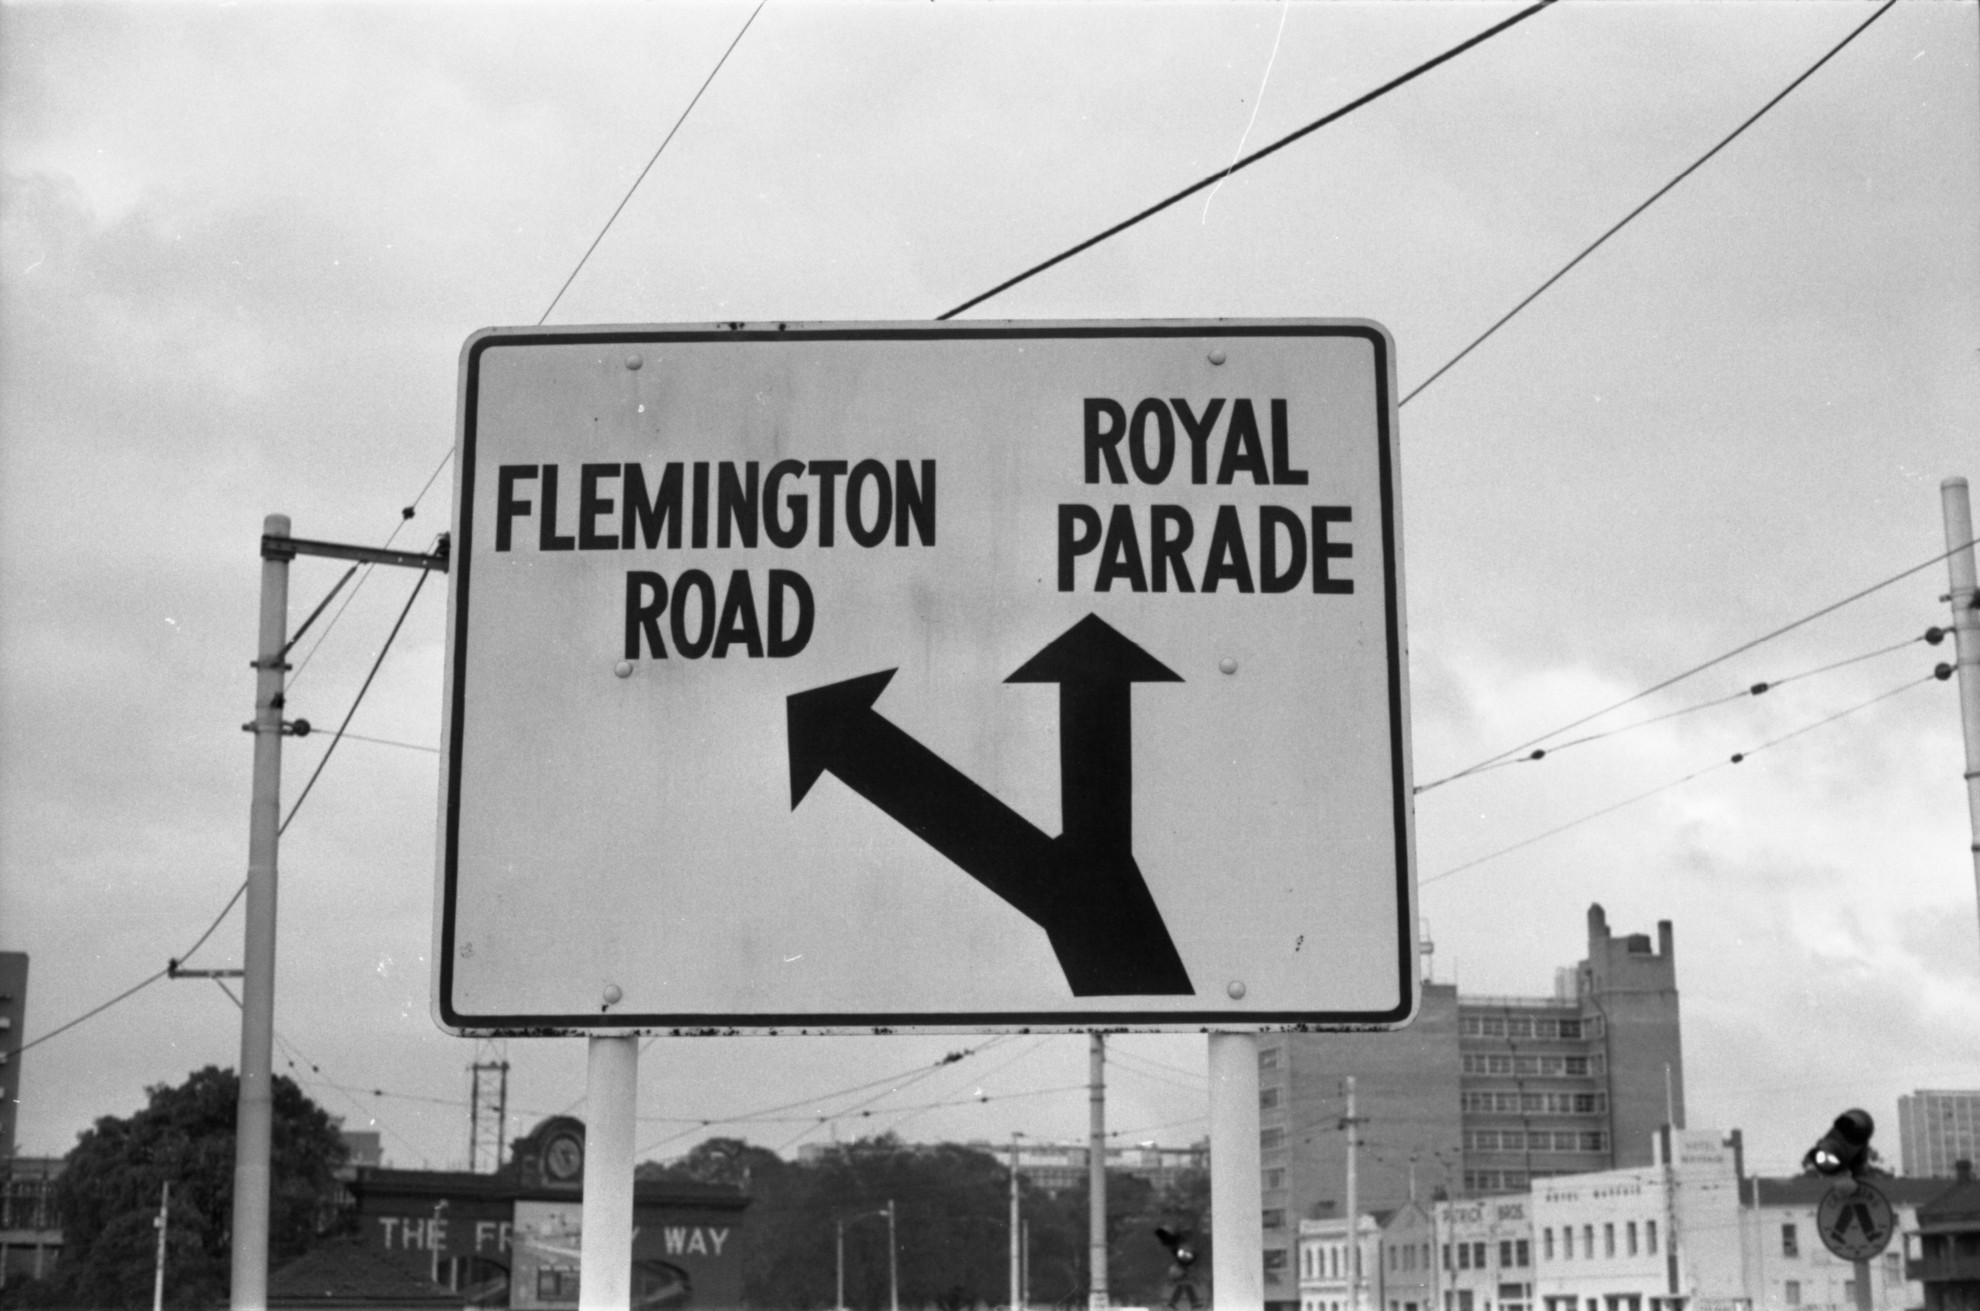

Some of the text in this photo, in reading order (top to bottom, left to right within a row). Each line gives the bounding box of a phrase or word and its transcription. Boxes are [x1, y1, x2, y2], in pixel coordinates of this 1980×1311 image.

[1083, 397, 1309, 486] ROYAL
[495, 458, 936, 553] FLEMINGTON
[1057, 503, 1355, 595] PARADE
[624, 568, 815, 660] ROAD
[379, 1216, 448, 1250] THE
[664, 1225, 729, 1255] WAY
